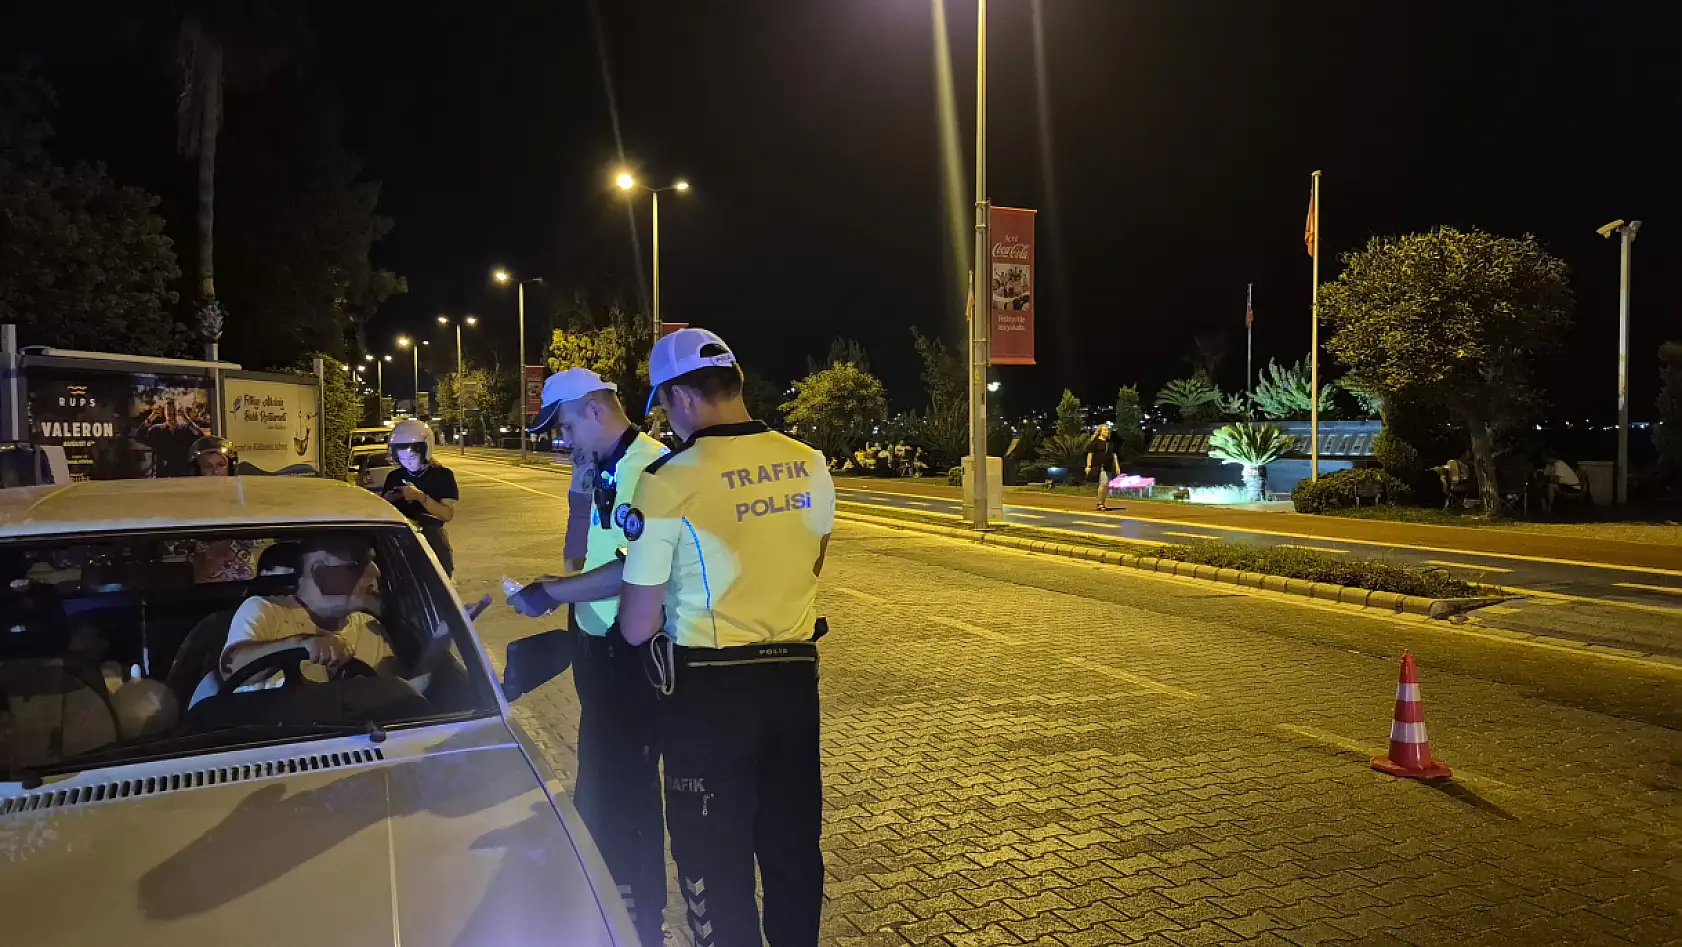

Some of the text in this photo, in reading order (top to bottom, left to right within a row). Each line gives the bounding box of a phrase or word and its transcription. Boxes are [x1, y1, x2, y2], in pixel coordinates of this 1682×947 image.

[58, 397, 96, 407] RUPS
[41, 421, 114, 437] VALERON
[720, 460, 810, 490] TRAFİK
[735, 491, 812, 523] POLİSİ
